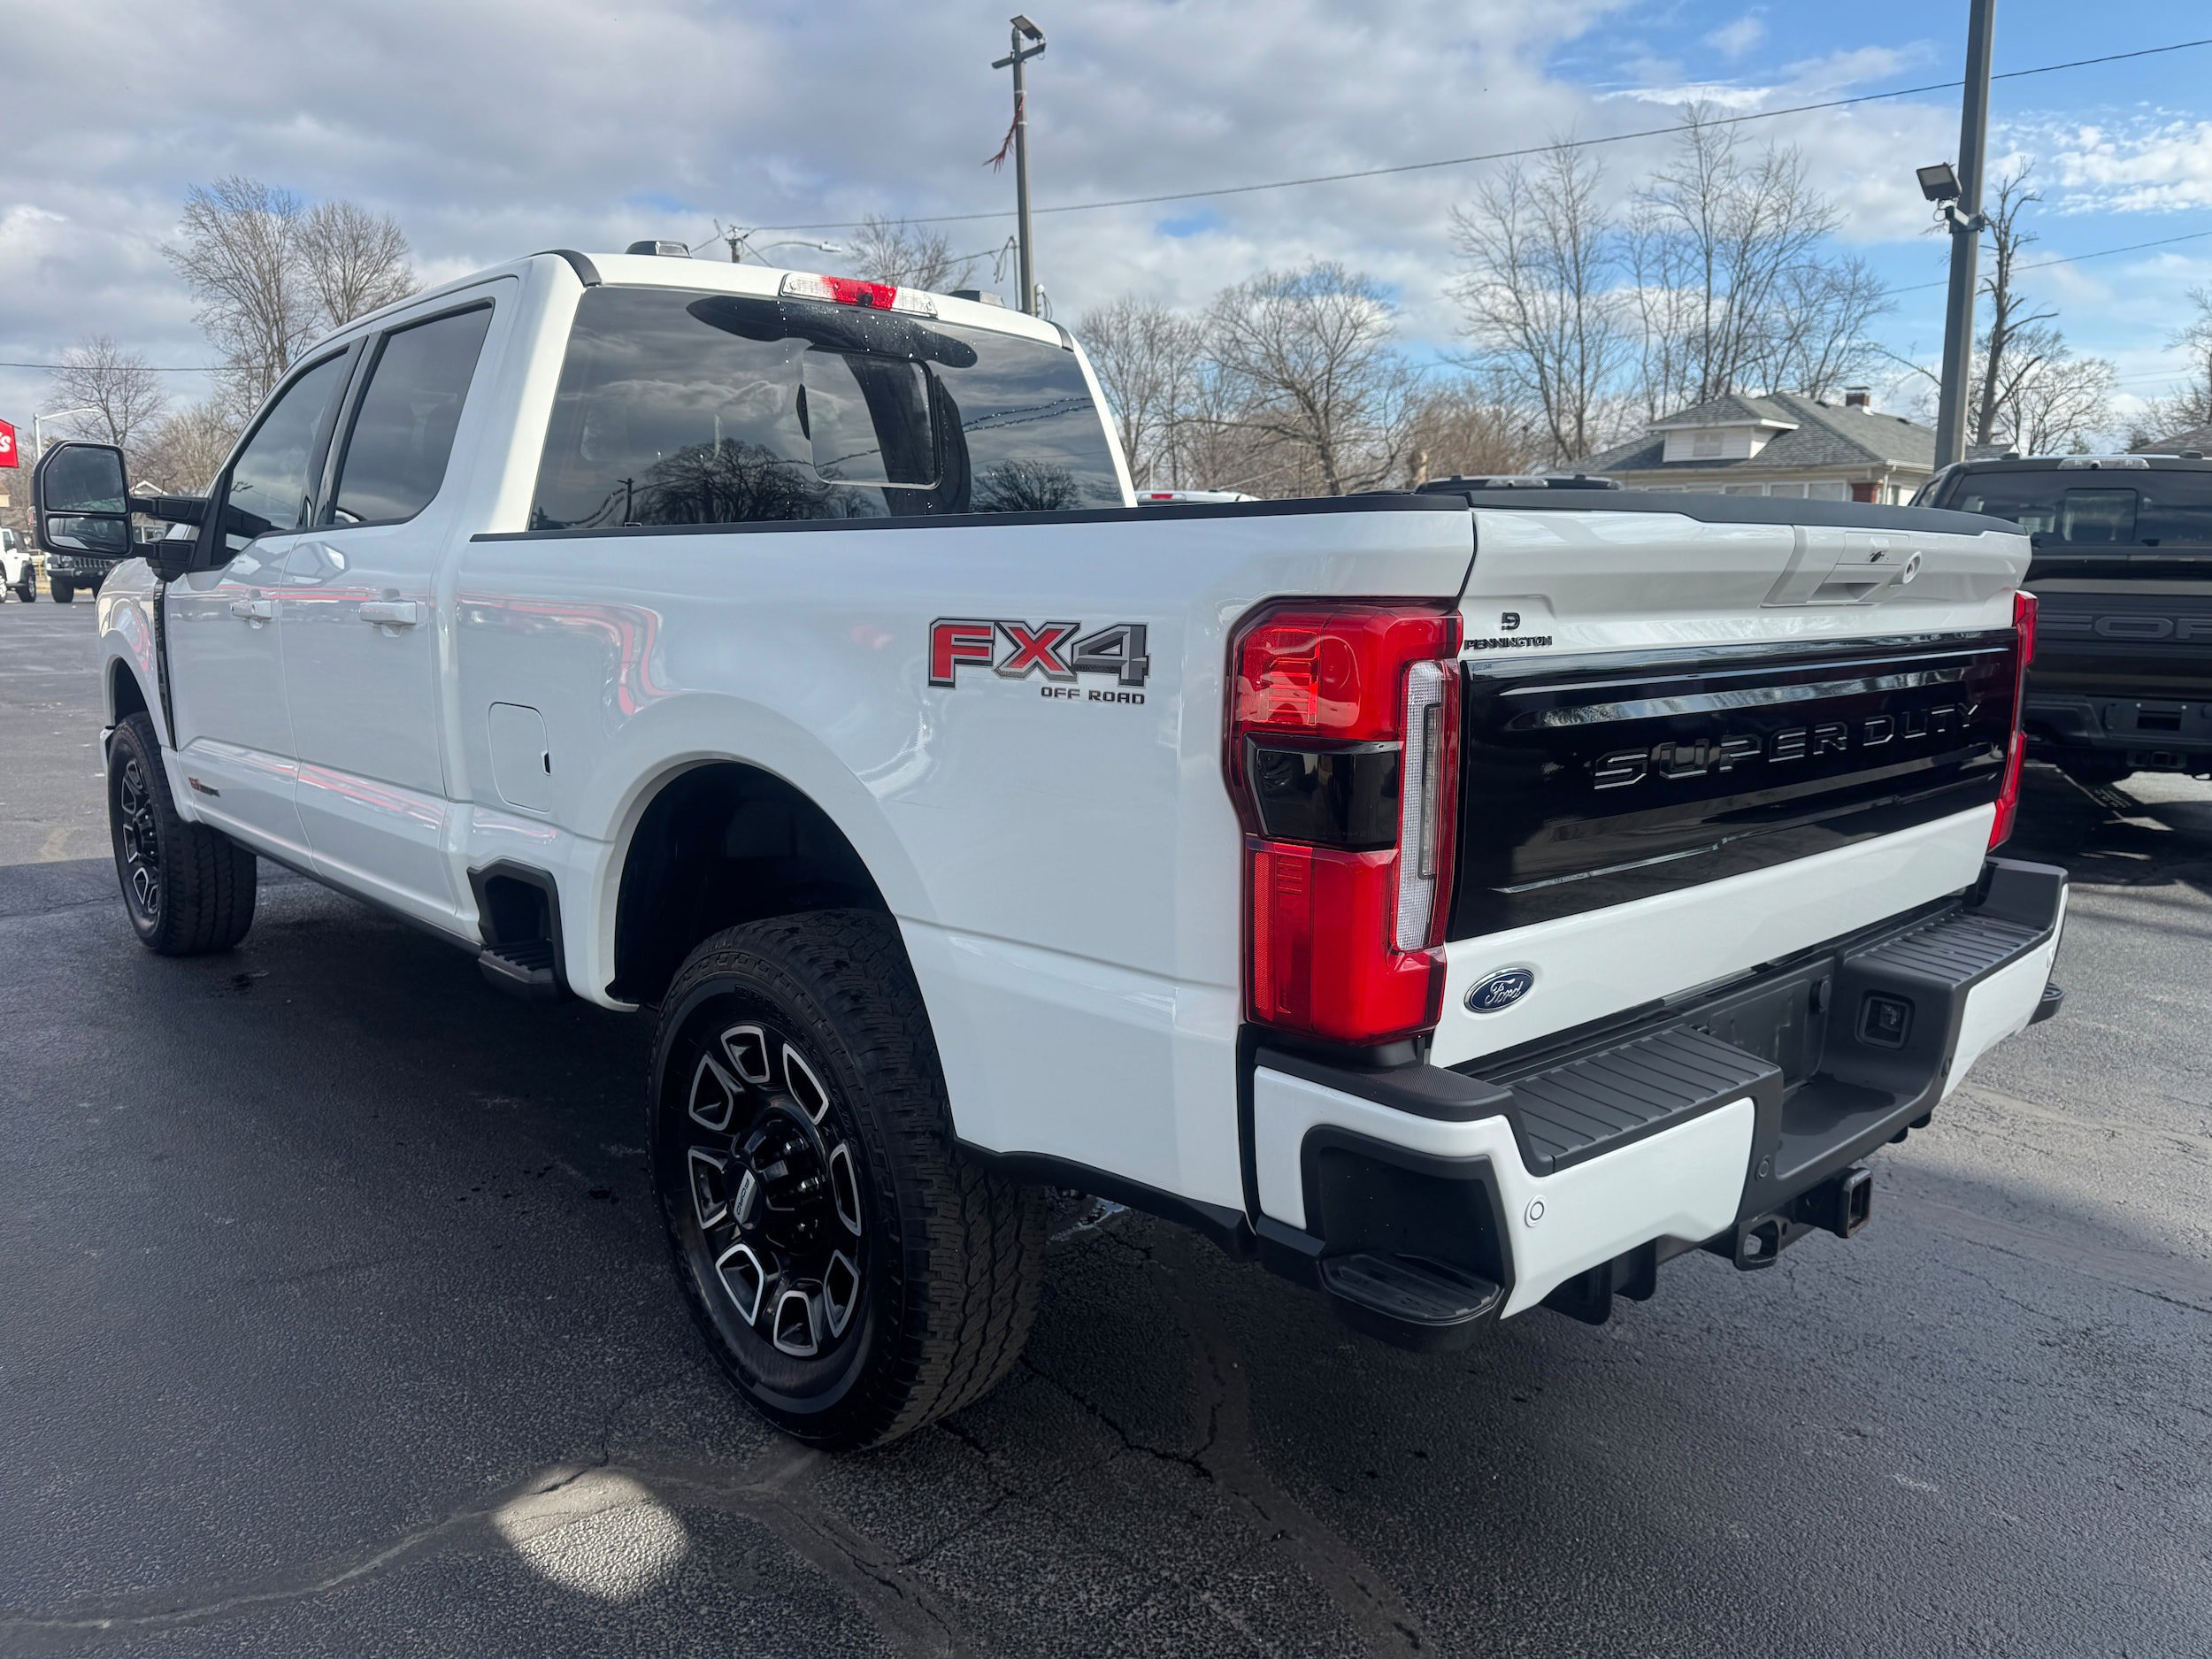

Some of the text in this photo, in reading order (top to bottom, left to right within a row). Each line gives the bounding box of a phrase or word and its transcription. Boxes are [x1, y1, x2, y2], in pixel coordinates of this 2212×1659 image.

[928, 616, 1150, 689] FX4
[1463, 635, 1553, 650] PENNINGTON
[1041, 687, 1146, 704] OFF ROAD
[1594, 702, 1980, 790] SUPER DUTY
[1484, 977, 1524, 1007] Ford
[736, 1177, 750, 1216] FORD
